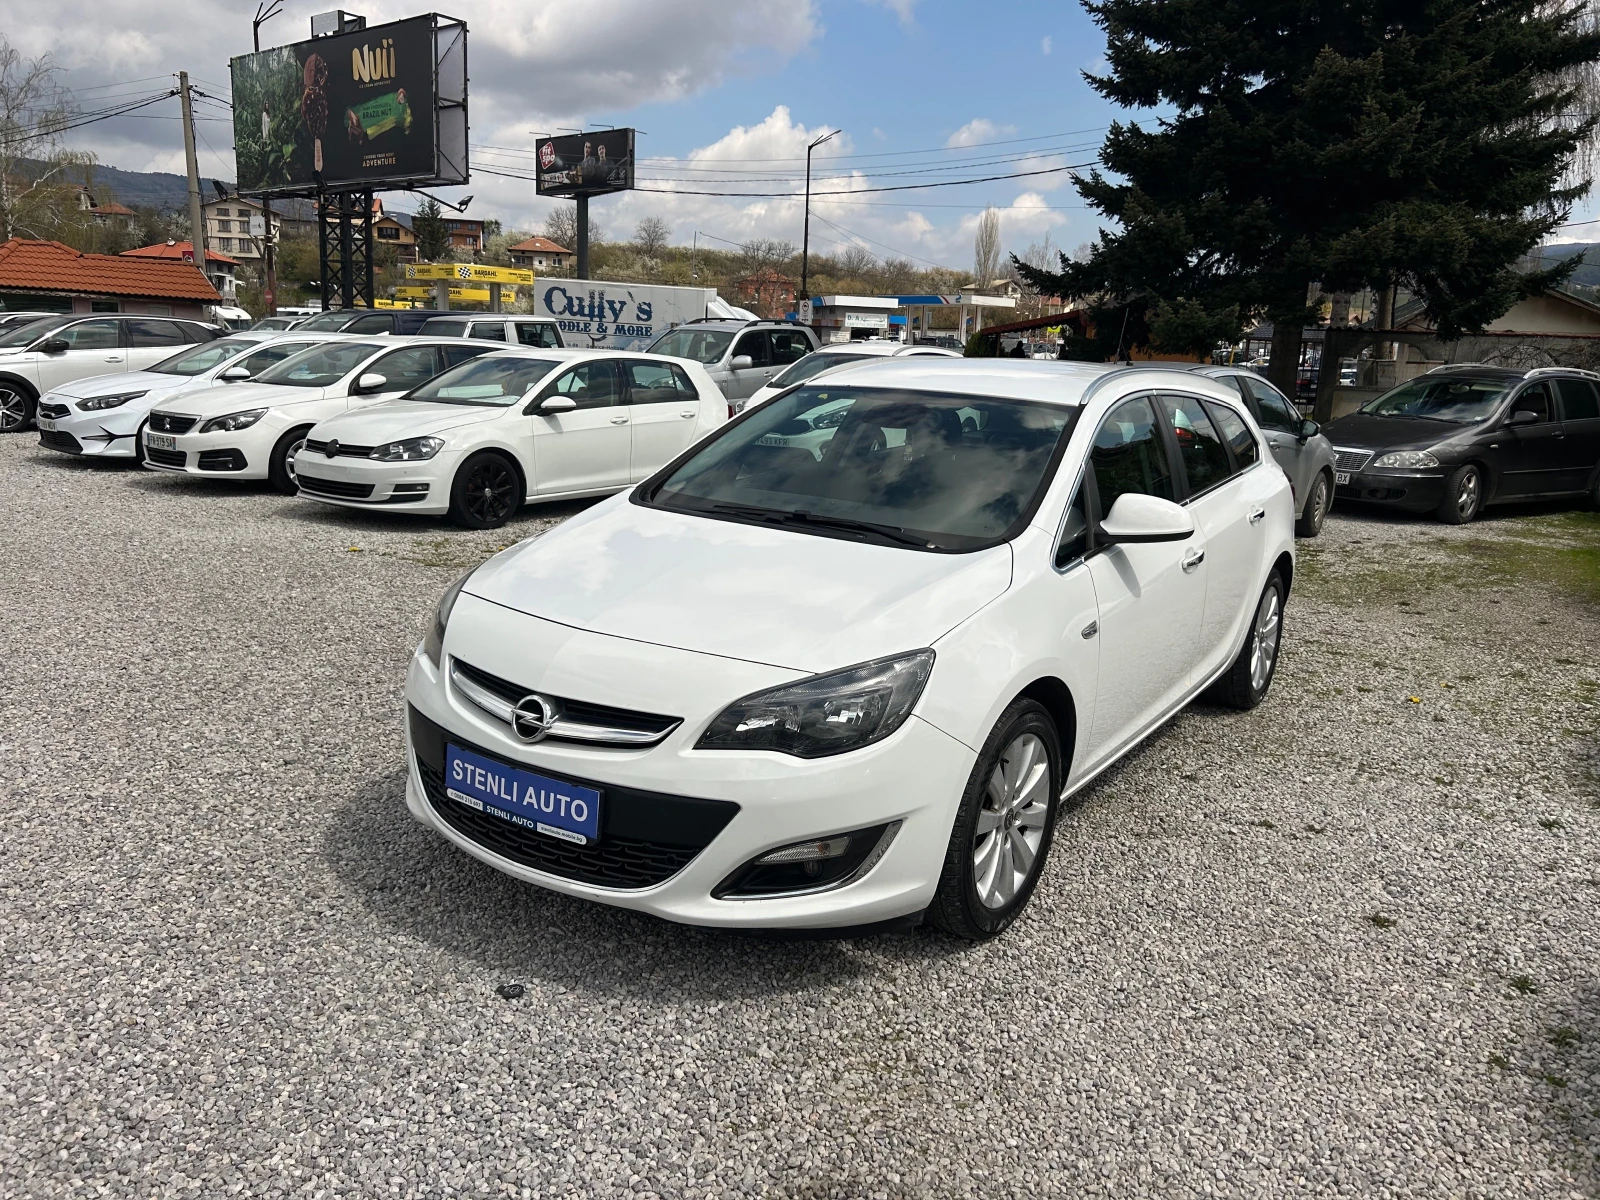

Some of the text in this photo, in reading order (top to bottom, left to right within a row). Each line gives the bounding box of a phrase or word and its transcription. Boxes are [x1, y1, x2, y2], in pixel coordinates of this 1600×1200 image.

[362, 107, 392, 120] BRAZIL NUT
[362, 157, 396, 167] ADVENTURE
[474, 269, 498, 278] BARDAHL
[596, 322, 608, 334] &
[613, 324, 653, 337] MORE
[452, 759, 588, 822] STENLI AUTO
[486, 805, 534, 828] STENLI AUTO
